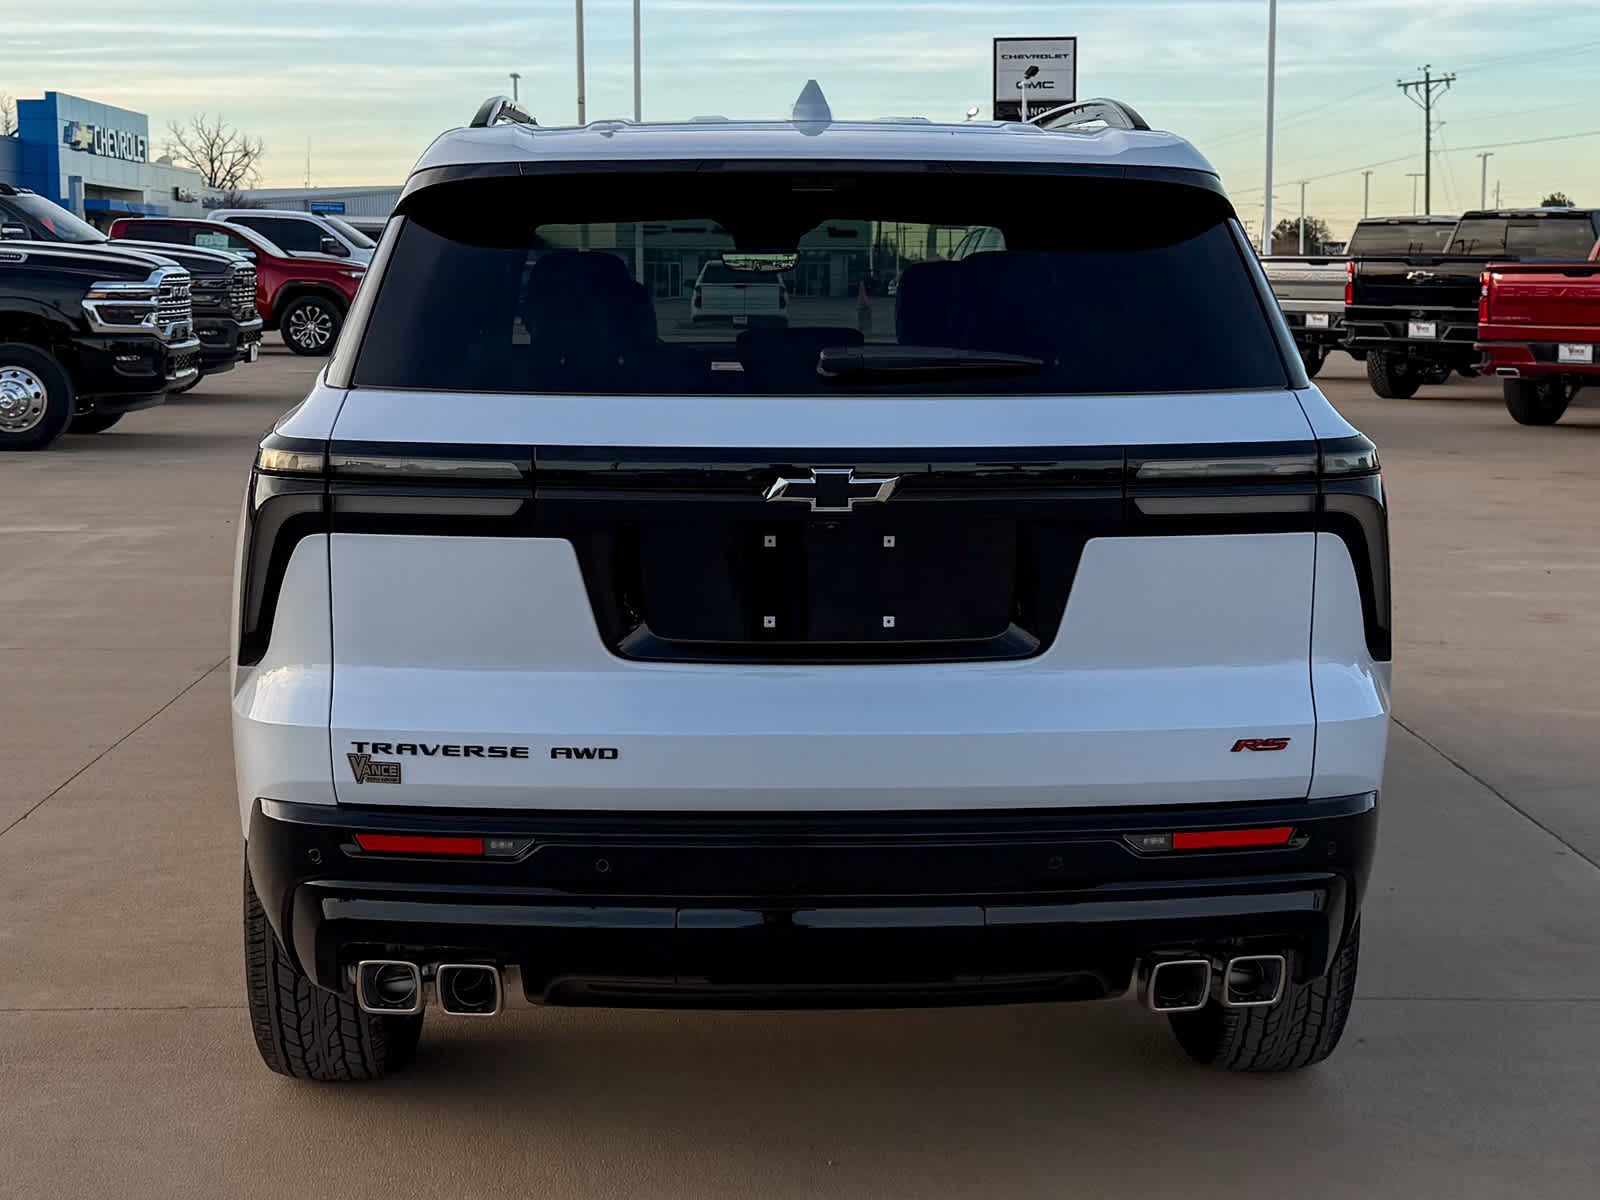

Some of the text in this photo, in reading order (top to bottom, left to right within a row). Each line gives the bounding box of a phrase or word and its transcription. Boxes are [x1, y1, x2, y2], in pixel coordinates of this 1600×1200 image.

[351, 741, 619, 760] TRAVERSE AWD
[1230, 737, 1292, 752] RS
[347, 753, 400, 784] VANCE
